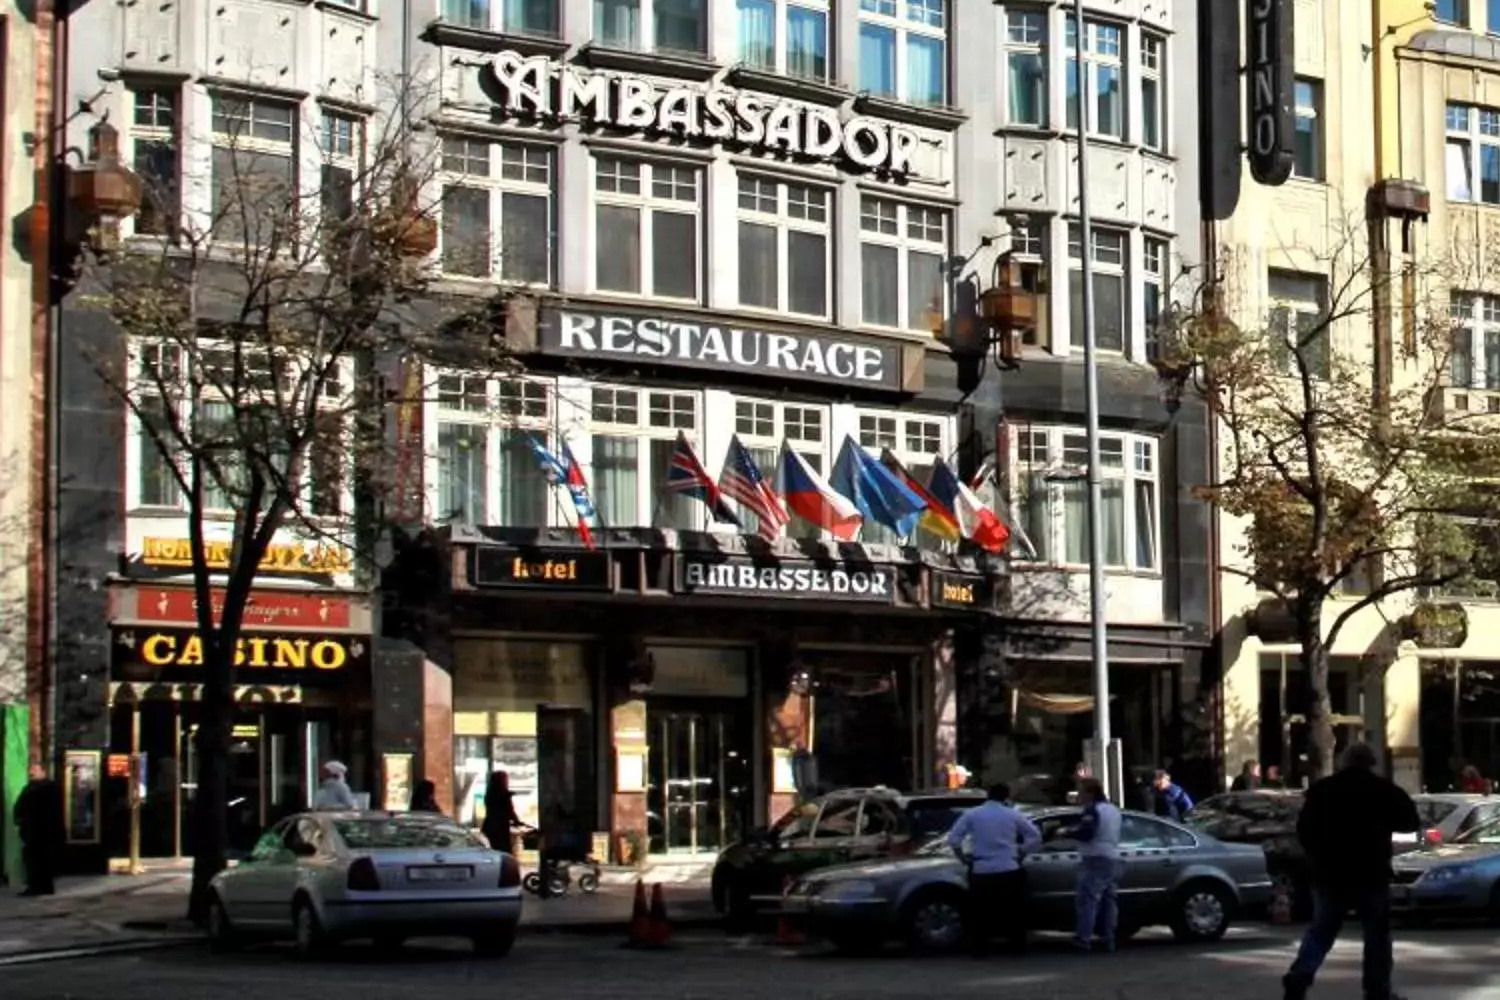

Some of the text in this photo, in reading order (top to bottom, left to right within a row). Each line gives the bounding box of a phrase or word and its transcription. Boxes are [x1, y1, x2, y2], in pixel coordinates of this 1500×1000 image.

[492, 50, 918, 174] AMBASSADOR
[558, 311, 884, 382] RESTAURACE
[512, 555, 577, 580] hotel
[686, 561, 888, 594] AMBASSADOR
